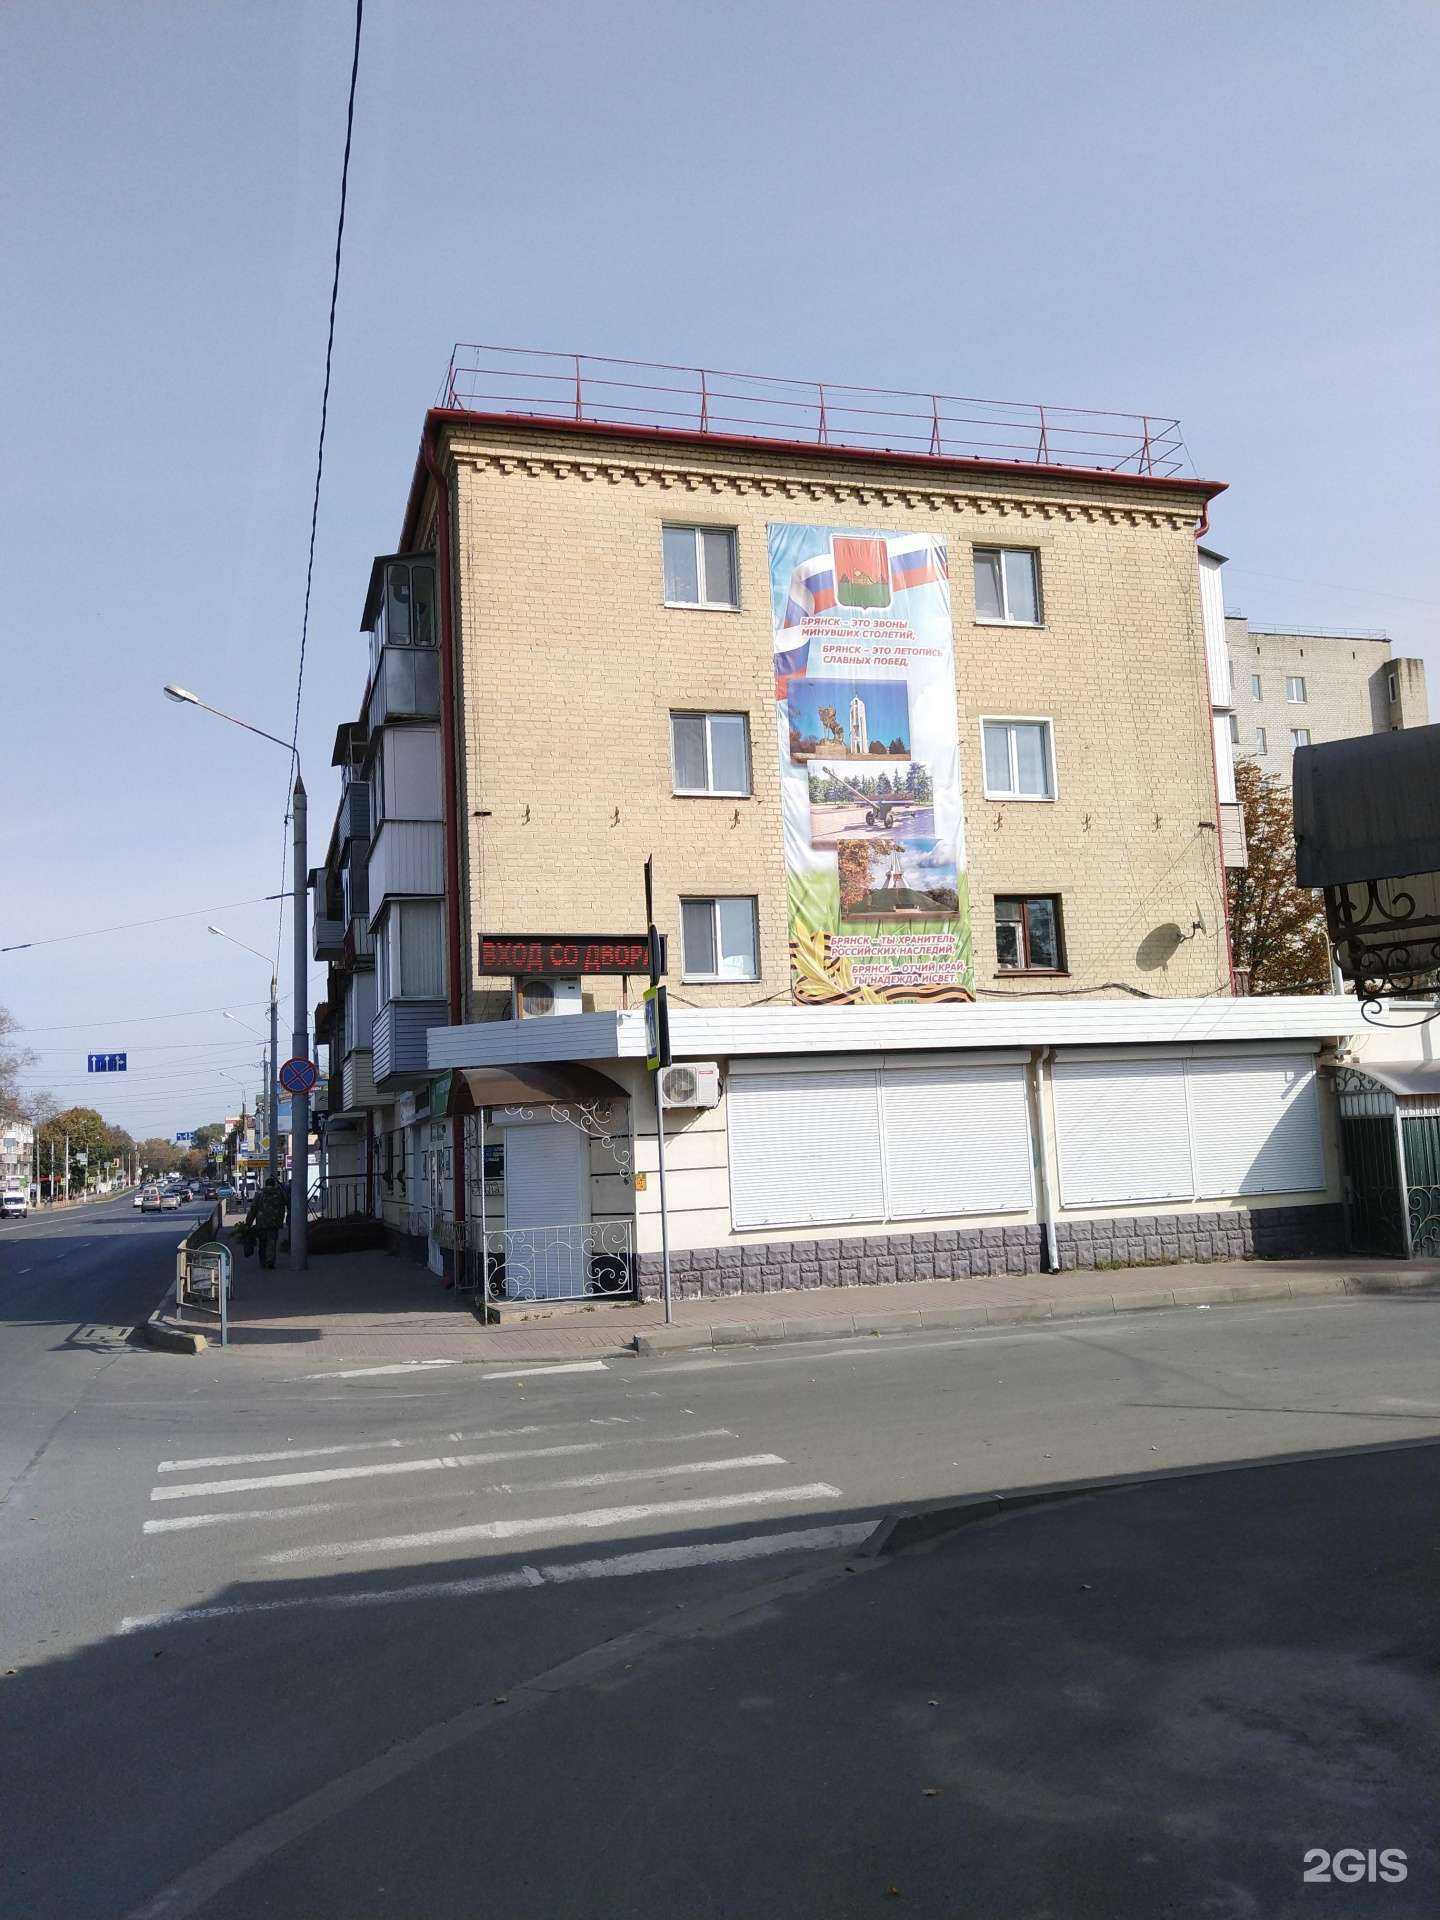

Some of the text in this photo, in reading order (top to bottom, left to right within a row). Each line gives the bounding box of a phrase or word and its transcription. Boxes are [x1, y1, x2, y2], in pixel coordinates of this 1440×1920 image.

[802, 629, 860, 637] МИНУВШИХ
[822, 645, 861, 653] БРЯНСК
[823, 656, 871, 664] СЛАВНЫХ
[831, 937, 869, 945] БРЯНСК
[898, 935, 956, 944] ХРАНИТЕЛЬ
[831, 947, 897, 956] РОССИЙСКИХ
[483, 943, 543, 971] ВХОД
[551, 944, 579, 966] СО
[852, 965, 890, 973] БРЯНСК
[902, 962, 935, 973] ОТЧИЙ
[854, 976, 867, 984] ТЫ
[871, 974, 920, 984] НАДЕЖДА
